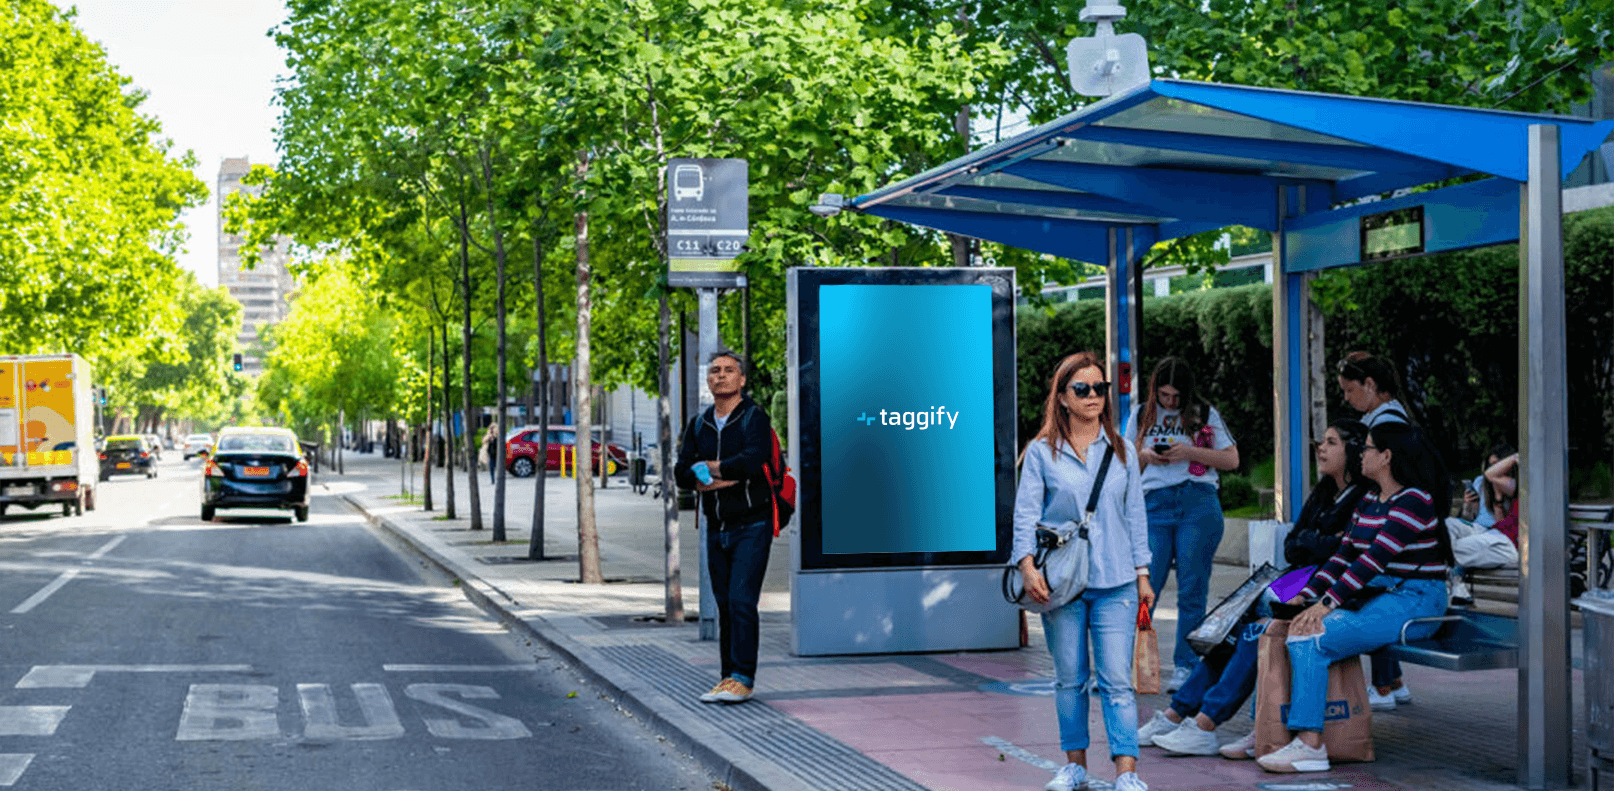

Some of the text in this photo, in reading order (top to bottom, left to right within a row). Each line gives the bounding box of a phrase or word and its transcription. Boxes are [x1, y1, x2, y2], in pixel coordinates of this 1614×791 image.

[676, 240, 700, 251] C11
[716, 240, 741, 251] C20
[879, 405, 960, 431] taggify
[175, 682, 533, 741] BUS
